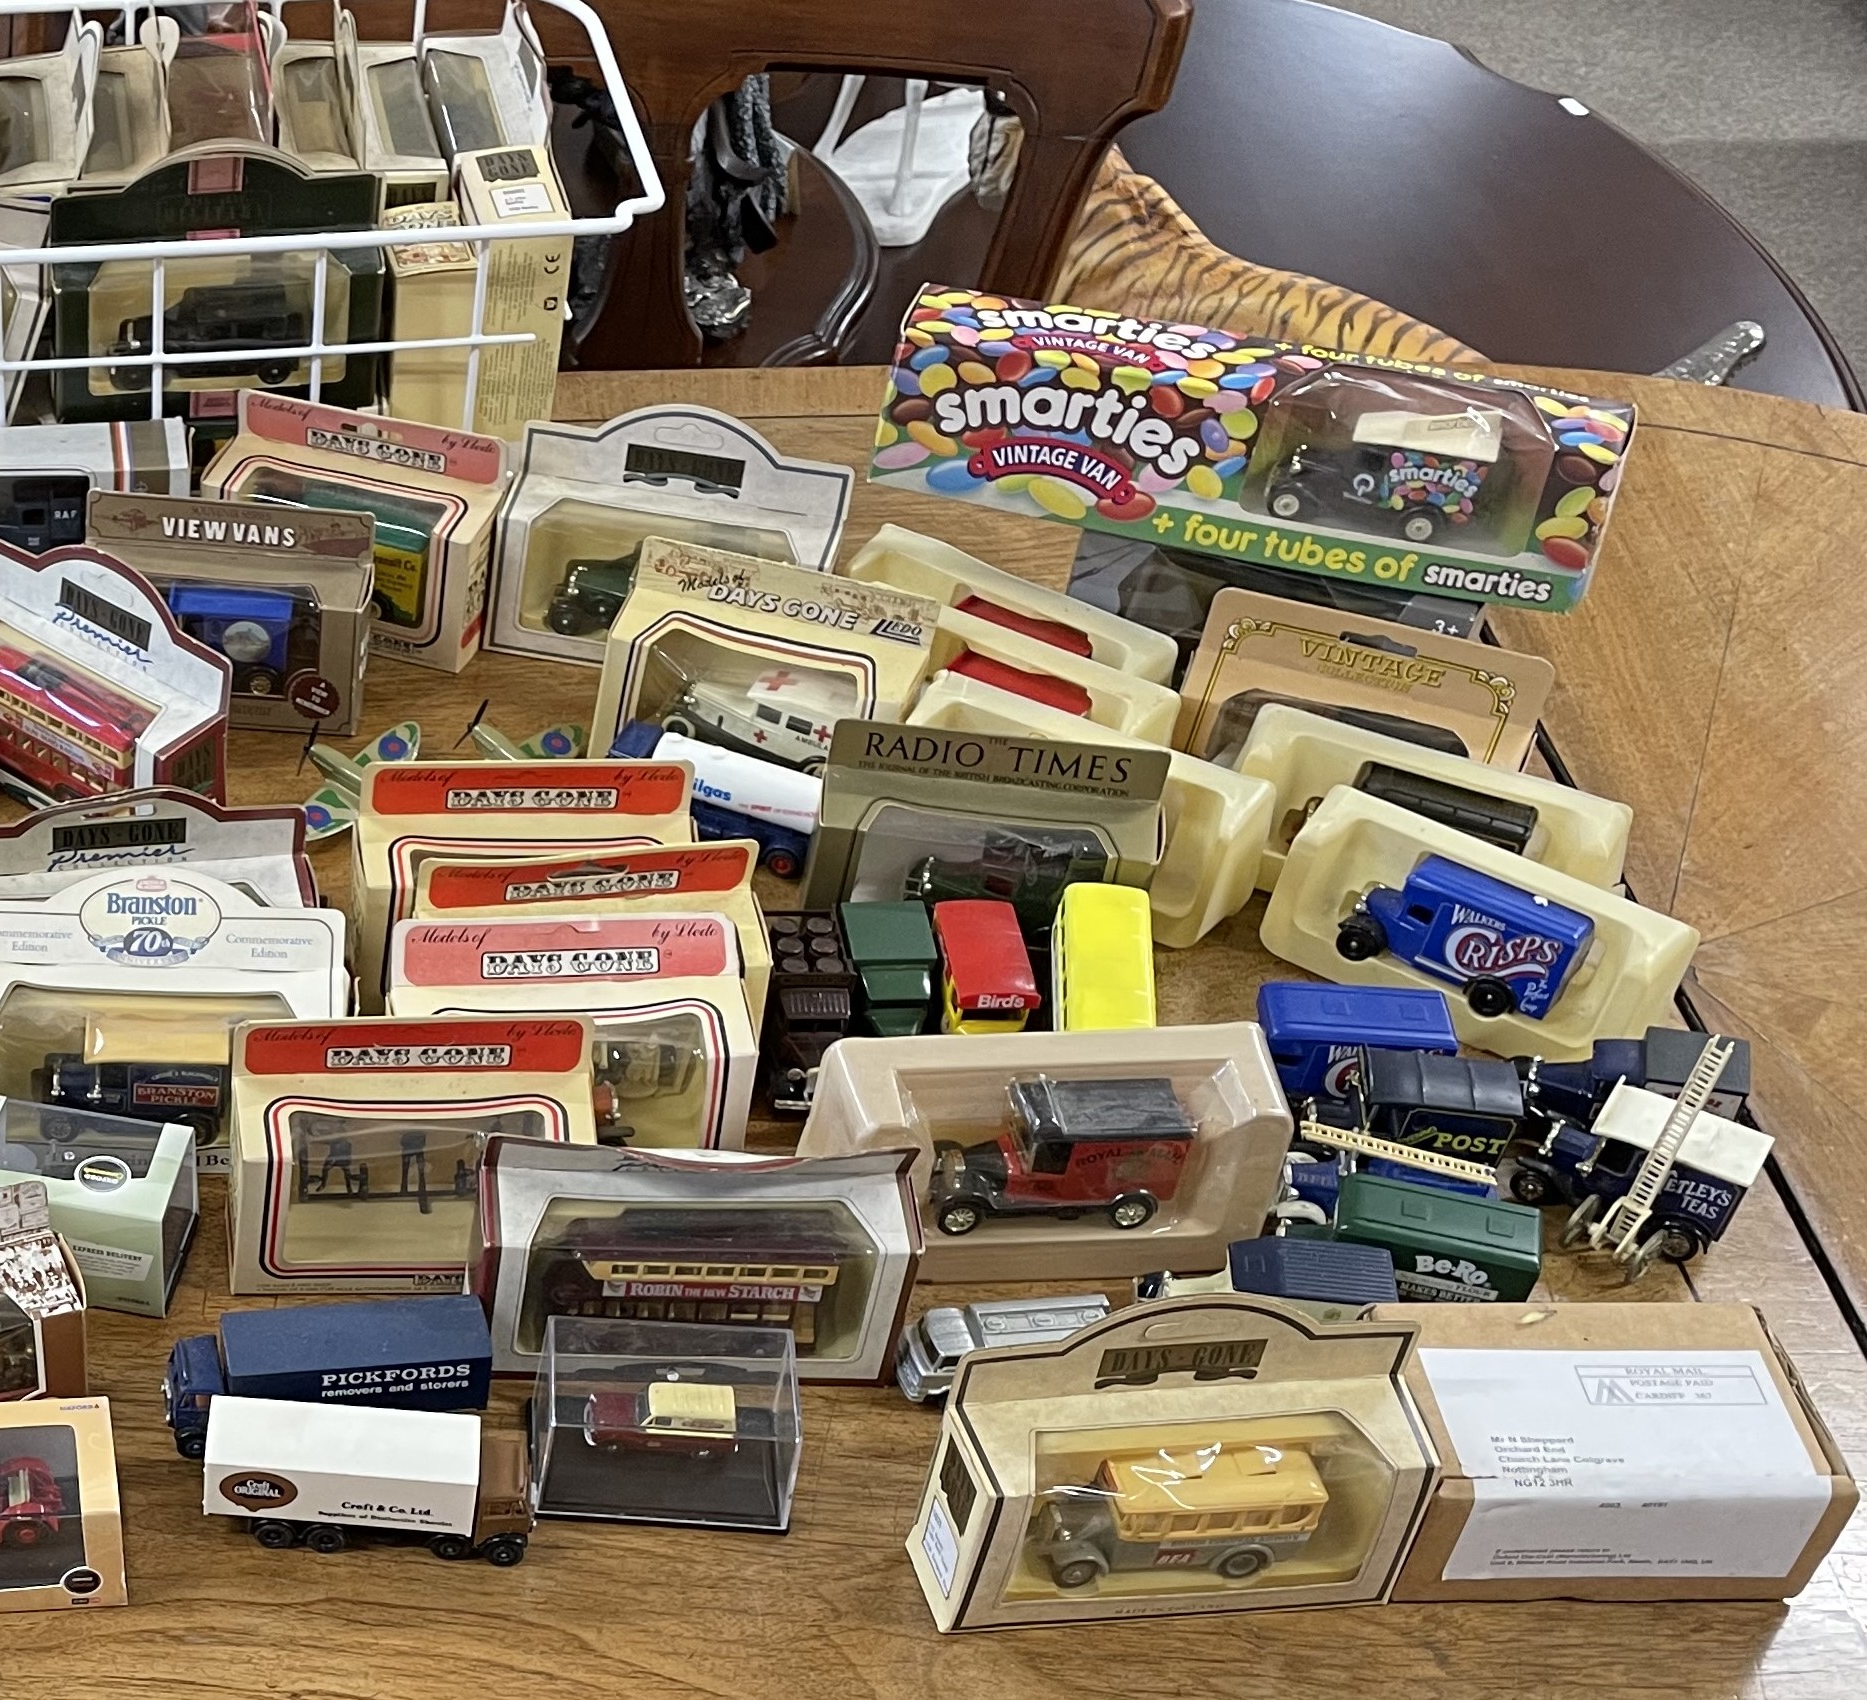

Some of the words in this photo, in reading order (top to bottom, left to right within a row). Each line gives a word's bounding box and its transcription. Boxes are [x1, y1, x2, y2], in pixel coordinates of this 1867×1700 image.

[976, 310, 1217, 360] smarties
[1031, 335, 1110, 354] VINTAGE
[1113, 345, 1151, 366] VAN
[1301, 344, 1360, 362] four
[1365, 355, 1447, 379] tubes
[1454, 371, 1486, 383] of
[1492, 377, 1590, 403] smarties
[935, 386, 1202, 476] smarties
[309, 429, 372, 454] DAYS
[375, 442, 444, 472] GONE
[992, 445, 1077, 471] VINTAGE
[1079, 456, 1124, 491] VAN
[1389, 463, 1478, 498] smarties
[53, 509, 78, 520] RAF
[1183, 511, 1260, 557] four
[1264, 530, 1367, 574] tubes
[1373, 552, 1419, 582] of
[1423, 563, 1552, 603] smarties
[706, 585, 778, 614] DAYS
[782, 599, 861, 631] GONE
[1299, 637, 1447, 688] VINTAGE
[794, 732, 829, 752] AMBULA
[863, 731, 985, 768] RADIO
[1007, 746, 1132, 784] TIMES
[450, 790, 525, 808] DAYS
[532, 790, 613, 808] GONE
[691, 779, 732, 803] ilgas
[47, 845, 196, 873] Premier
[106, 892, 198, 916] Branston
[131, 916, 168, 926] PICKLE
[1450, 903, 1506, 932] WALKERS
[11, 941, 49, 953] Edition
[225, 933, 314, 946] Commemorative
[250, 948, 289, 960] Edition
[485, 952, 563, 975] DAYS
[570, 950, 656, 973] GONE
[1444, 926, 1560, 978] CRISPS
[330, 1047, 412, 1067] DAYS
[418, 1046, 508, 1066] GONE
[136, 1086, 217, 1100] BRANSTON
[1432, 1132, 1508, 1156] POST
[1657, 1172, 1732, 1208] ETLEY'S
[1680, 1195, 1720, 1220] TEAS
[628, 1282, 683, 1298] ROBIN
[728, 1284, 796, 1300] STARCH
[1111, 1348, 1173, 1374] DAYS
[1192, 1342, 1256, 1368] GONE
[321, 1363, 471, 1387] PICKFORDS
[1625, 1367, 1669, 1377] ROYAL
[1671, 1367, 1708, 1376] MAIL
[321, 1386, 385, 1398] removers
[389, 1382, 414, 1394] and
[420, 1379, 470, 1391] storers
[1501, 1466, 1568, 1475] Nottingham
[341, 1501, 373, 1512] Croft
[375, 1504, 386, 1513] &
